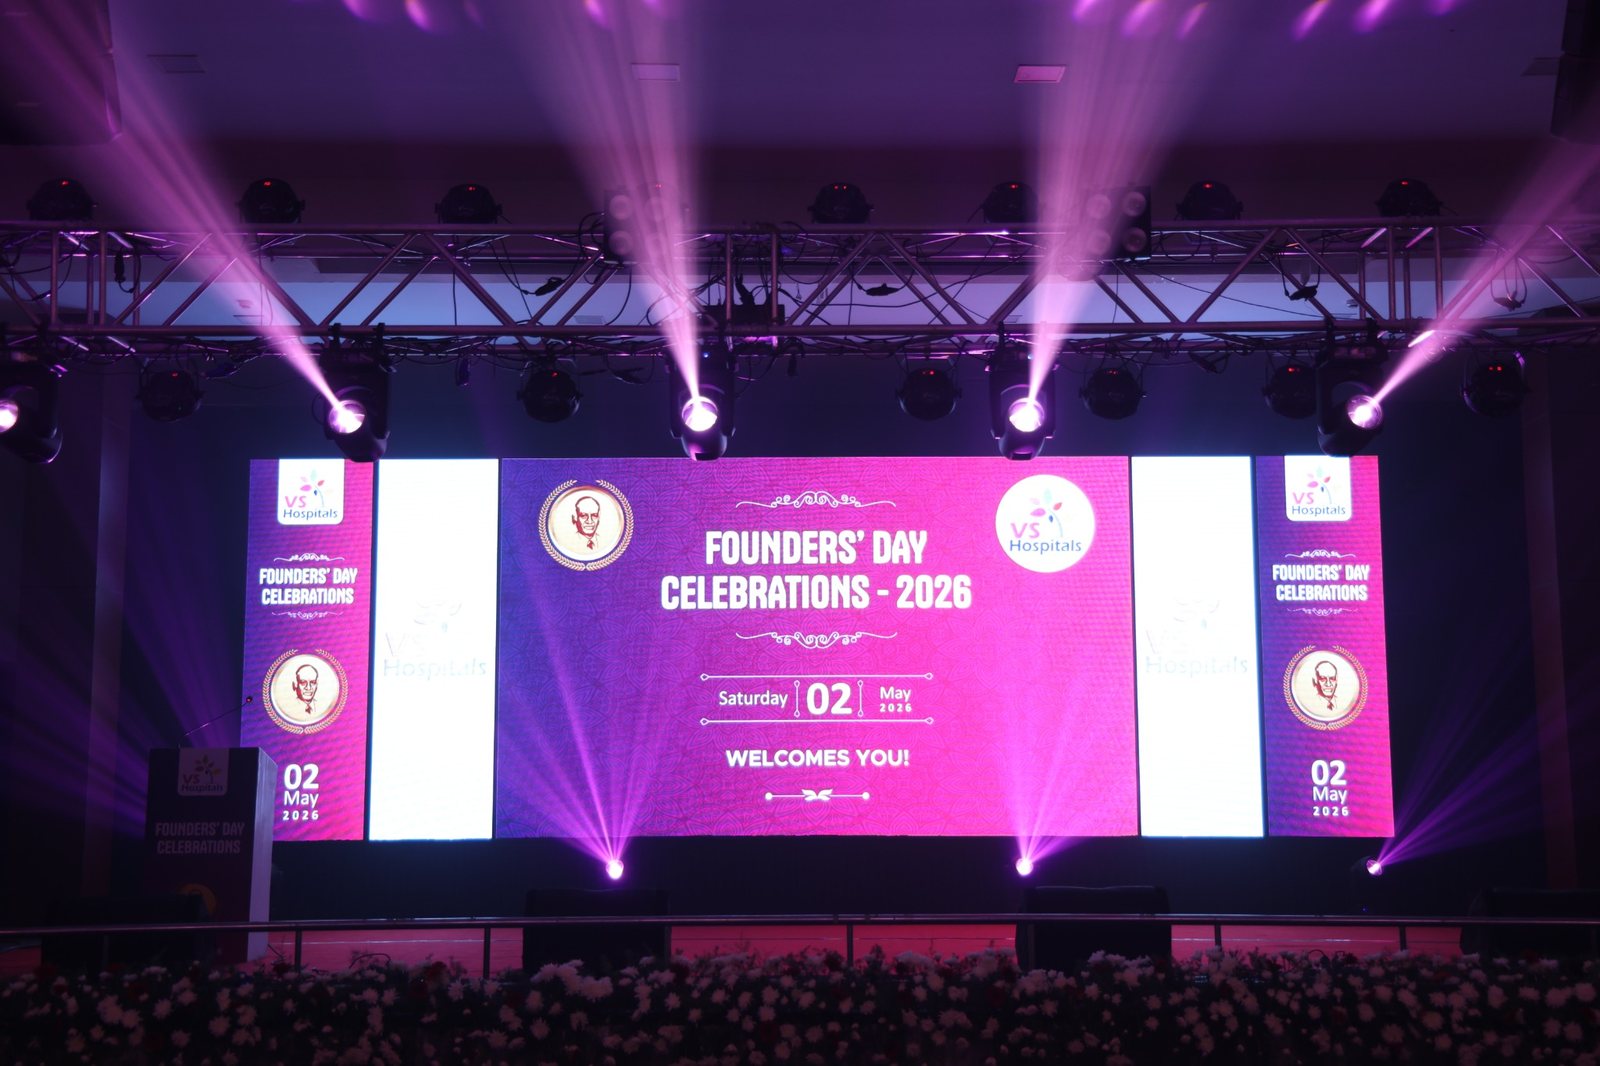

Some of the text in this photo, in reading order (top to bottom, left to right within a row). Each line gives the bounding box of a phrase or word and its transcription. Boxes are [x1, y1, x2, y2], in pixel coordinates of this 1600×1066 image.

[285, 496, 307, 508] VS
[1292, 492, 1315, 505] VS
[283, 509, 338, 520] Hospitals
[1291, 506, 1346, 517] Hospitals
[1010, 522, 1040, 539] VS
[705, 530, 928, 565] FOUNDERS’ DAY
[1009, 539, 1082, 555] Hospitals
[259, 568, 358, 584] FOUNDERS’ DAY
[1345, 564, 1370, 580] DAY
[261, 588, 355, 605] CELEBRATIONS
[660, 574, 870, 610] CELEBRATIONS
[896, 574, 973, 609] 2026
[1276, 584, 1369, 601] CELEBRATIONS
[718, 690, 788, 708] Saturday
[806, 682, 853, 715] 02
[879, 686, 911, 702] May
[879, 703, 912, 712] 2026
[725, 749, 910, 767] WELCOMES YOU!
[182, 773, 201, 785] VS
[284, 763, 319, 790] 02
[1311, 759, 1347, 786] 02
[283, 790, 319, 808] May
[1312, 786, 1347, 804] May
[282, 810, 319, 821] 2026
[1312, 806, 1349, 816] 2026
[223, 821, 246, 835] DAY
[157, 839, 241, 855] CELEBRATIONS
